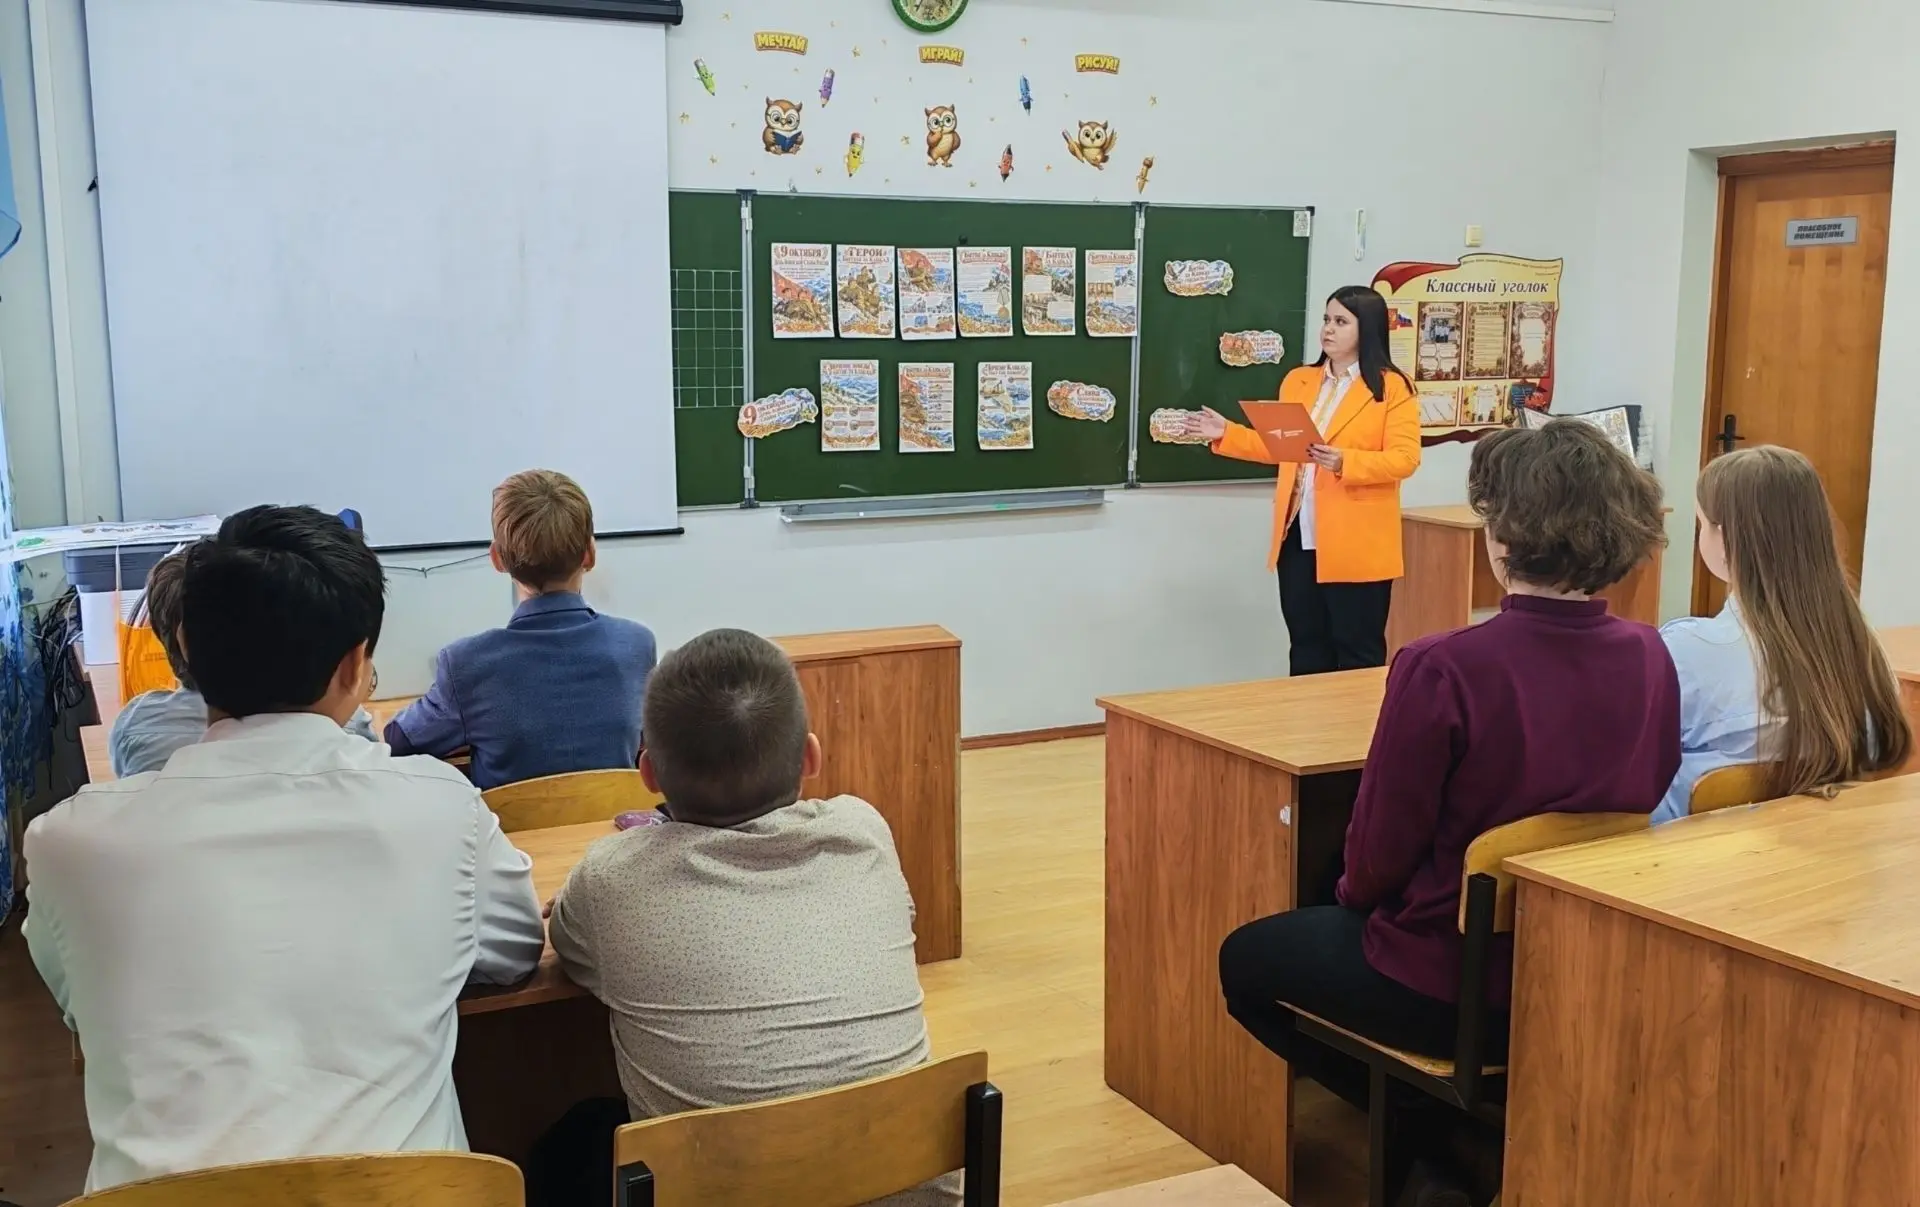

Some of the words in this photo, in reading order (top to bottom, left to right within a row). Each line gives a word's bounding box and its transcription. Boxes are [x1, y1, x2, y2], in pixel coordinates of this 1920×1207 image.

[922, 48, 963, 62] ИГРАЙ!
[1078, 56, 1118, 70] РИСУЙ!
[780, 245, 788, 257] 9
[849, 247, 882, 256] ГЕРОИ
[1426, 278, 1496, 293] Классный
[1500, 282, 1549, 297] уголок
[743, 405, 756, 425] 9
